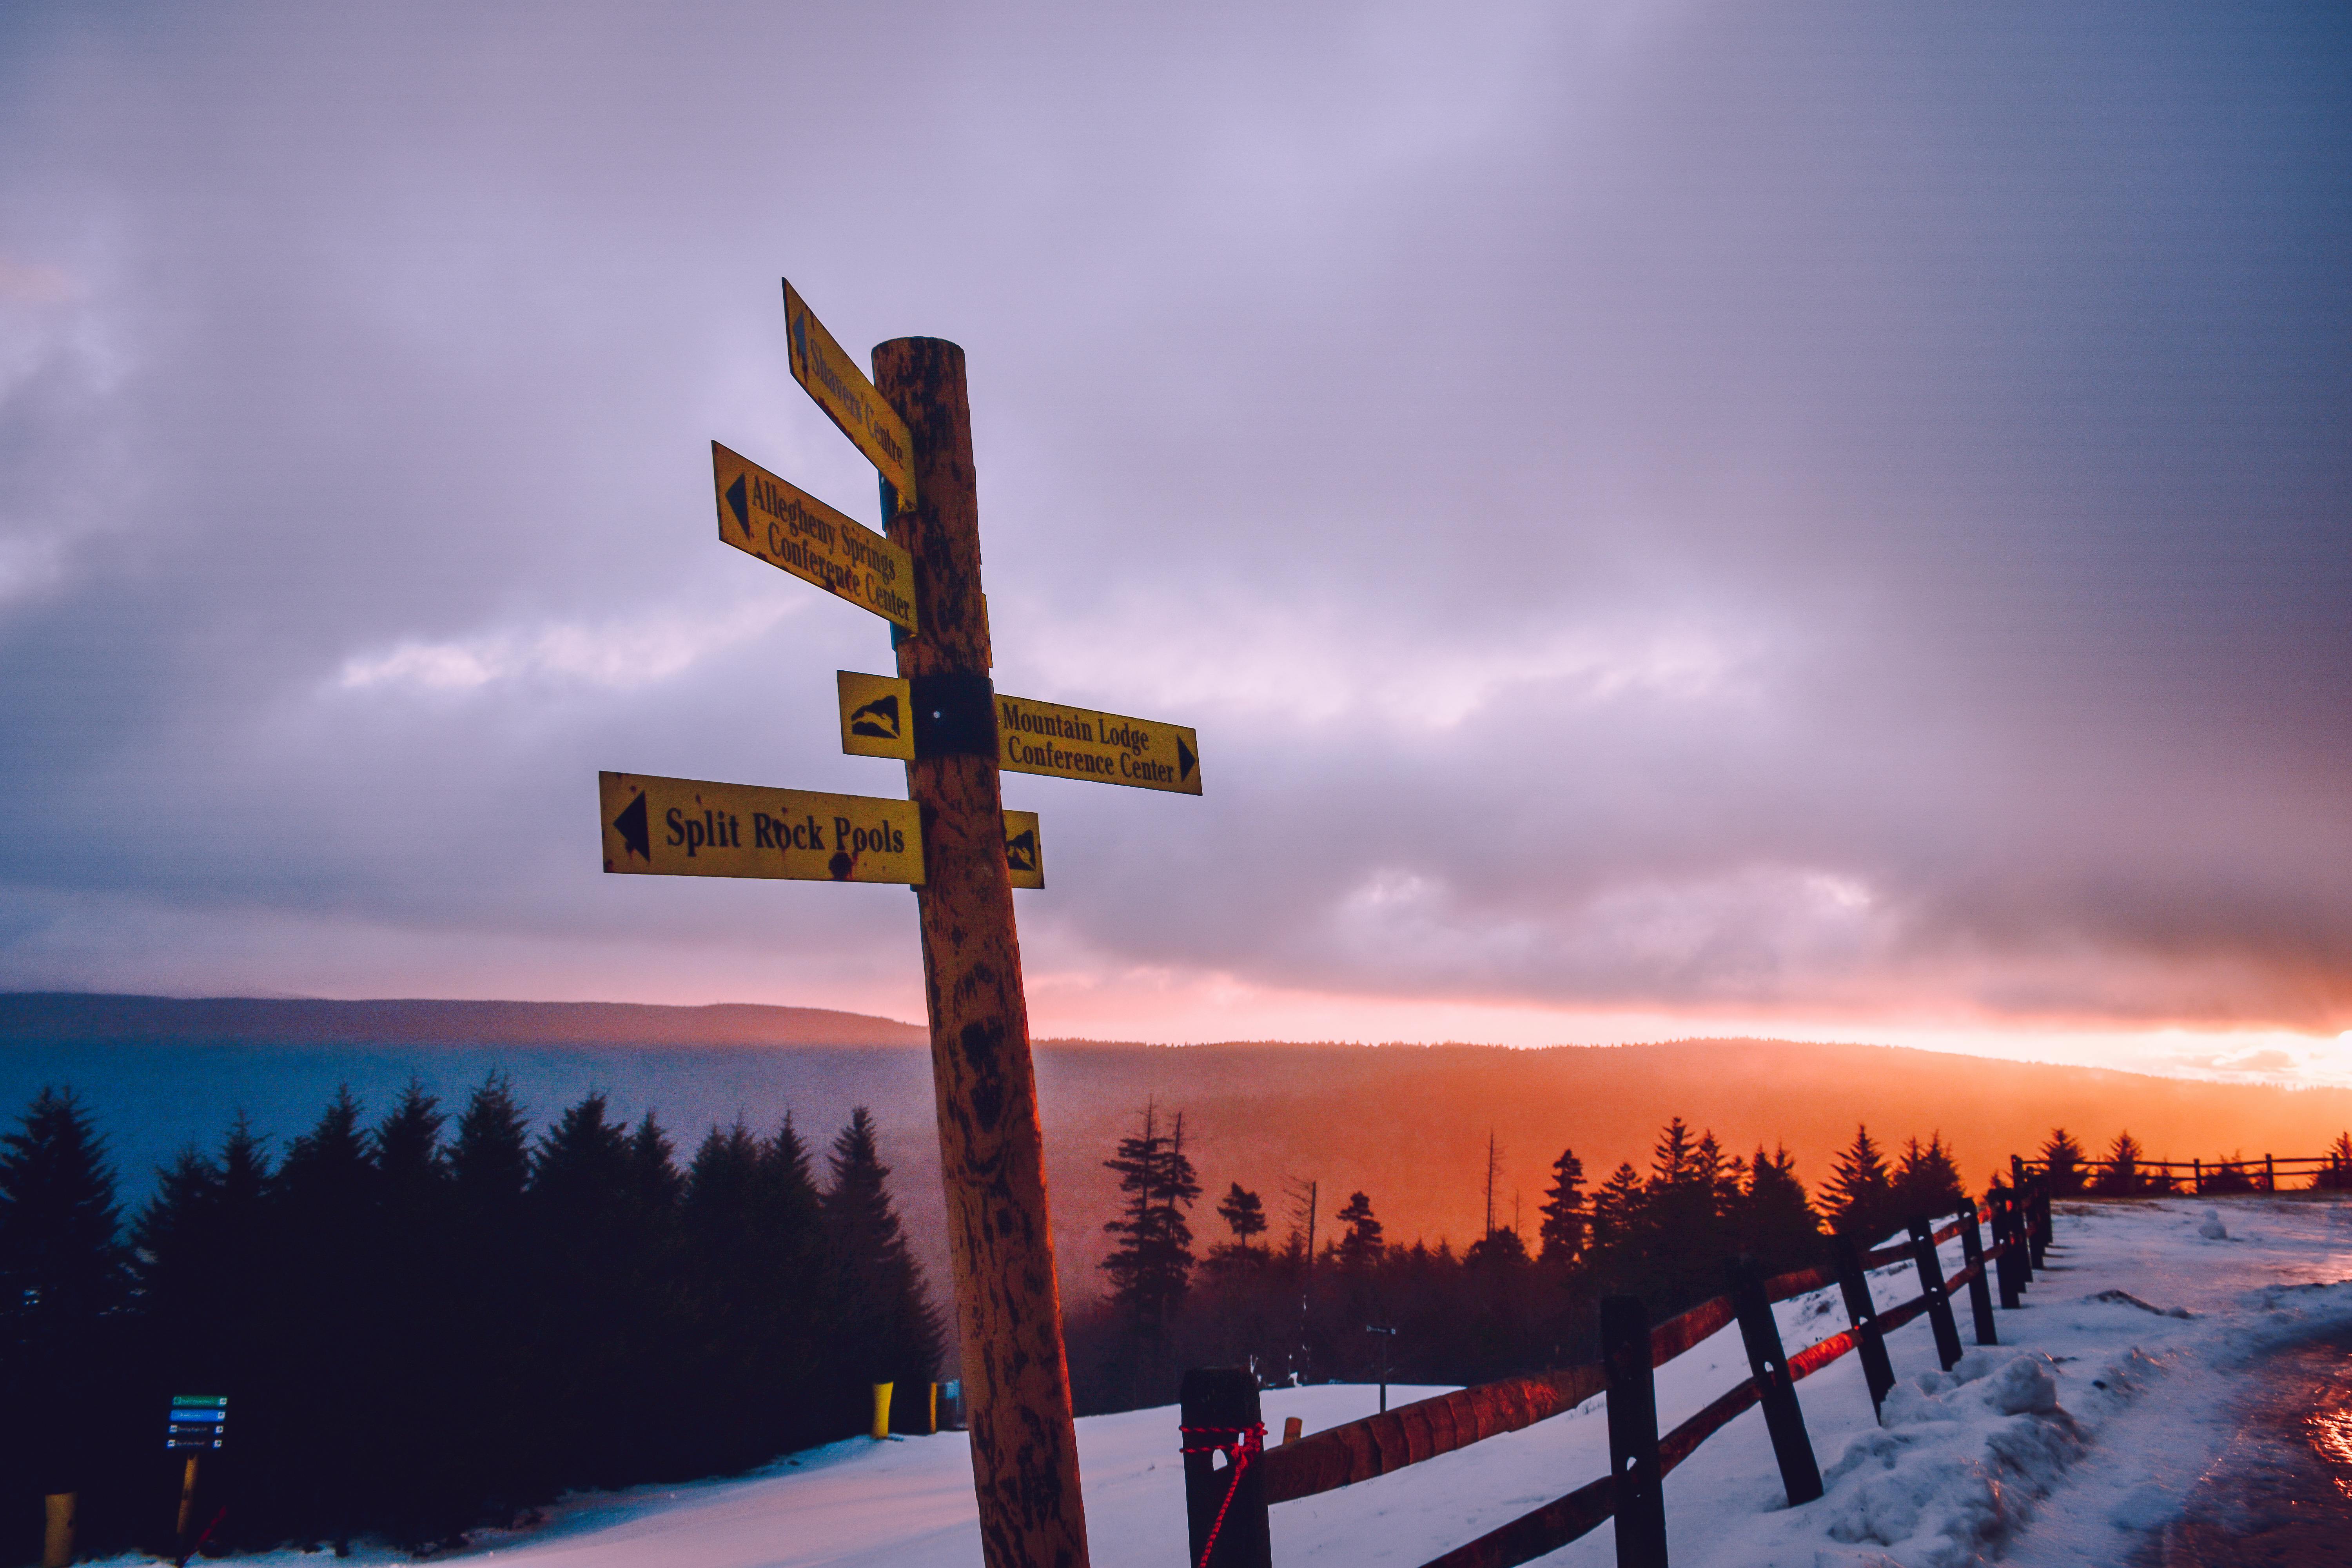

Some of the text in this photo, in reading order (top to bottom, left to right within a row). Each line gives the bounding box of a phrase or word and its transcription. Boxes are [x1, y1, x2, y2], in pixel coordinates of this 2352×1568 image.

[866, 402, 903, 470] Centre
[752, 475, 896, 585] Allegheny Springs
[768, 521, 909, 622] Conference Center
[1002, 702, 1149, 756] Mountain Lodge
[1008, 735, 1174, 783] Conference Center
[666, 808, 905, 857] Split Rock Pools
